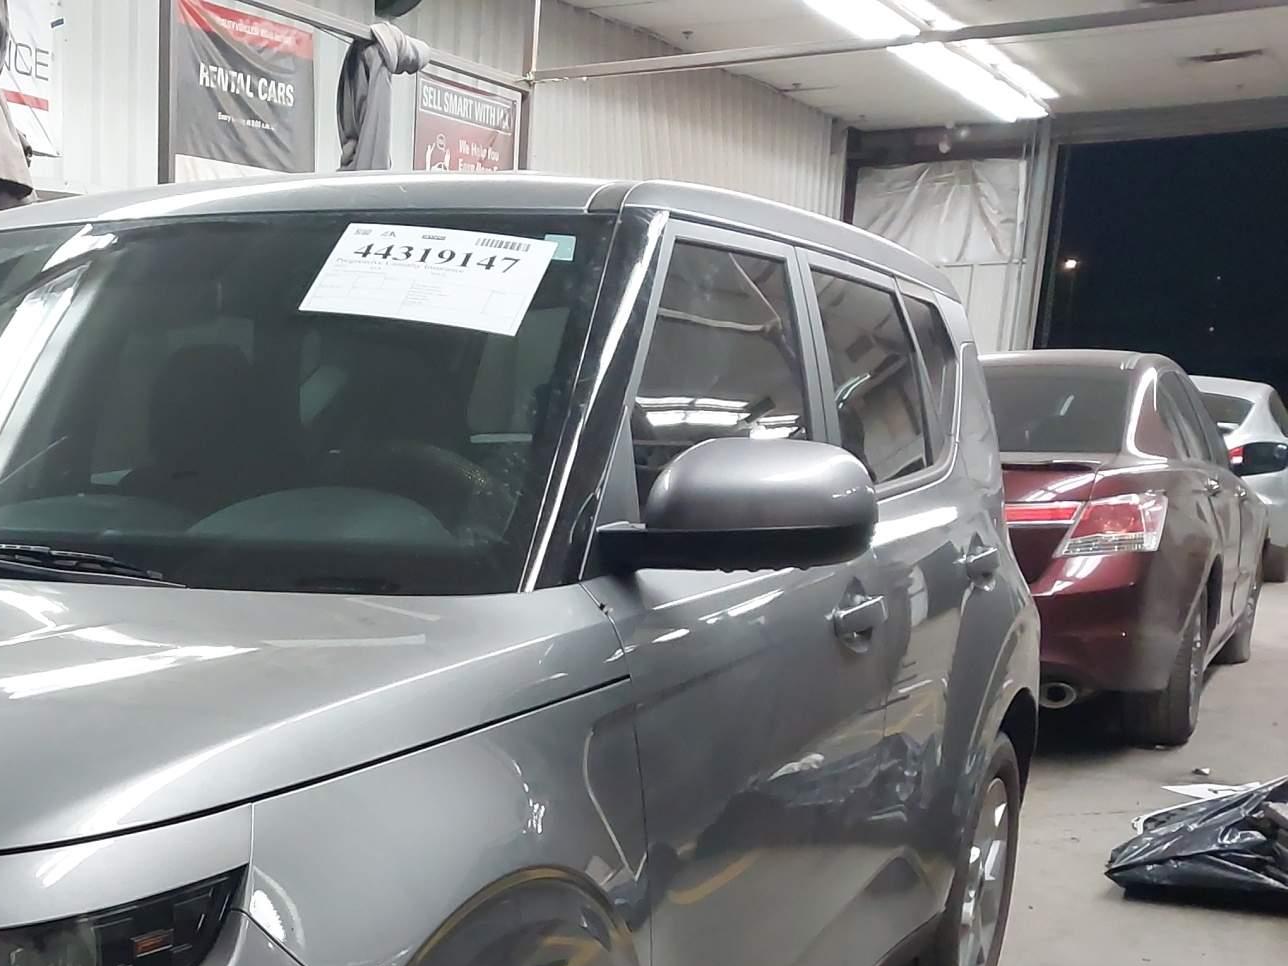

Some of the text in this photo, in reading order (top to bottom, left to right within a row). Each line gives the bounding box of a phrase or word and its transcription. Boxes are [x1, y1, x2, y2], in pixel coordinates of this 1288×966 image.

[199, 62, 294, 107] RENTAL CARS
[422, 85, 443, 111] SELL
[443, 92, 473, 119] SMART
[473, 101, 497, 127] WITH
[353, 242, 521, 274] 44319147
